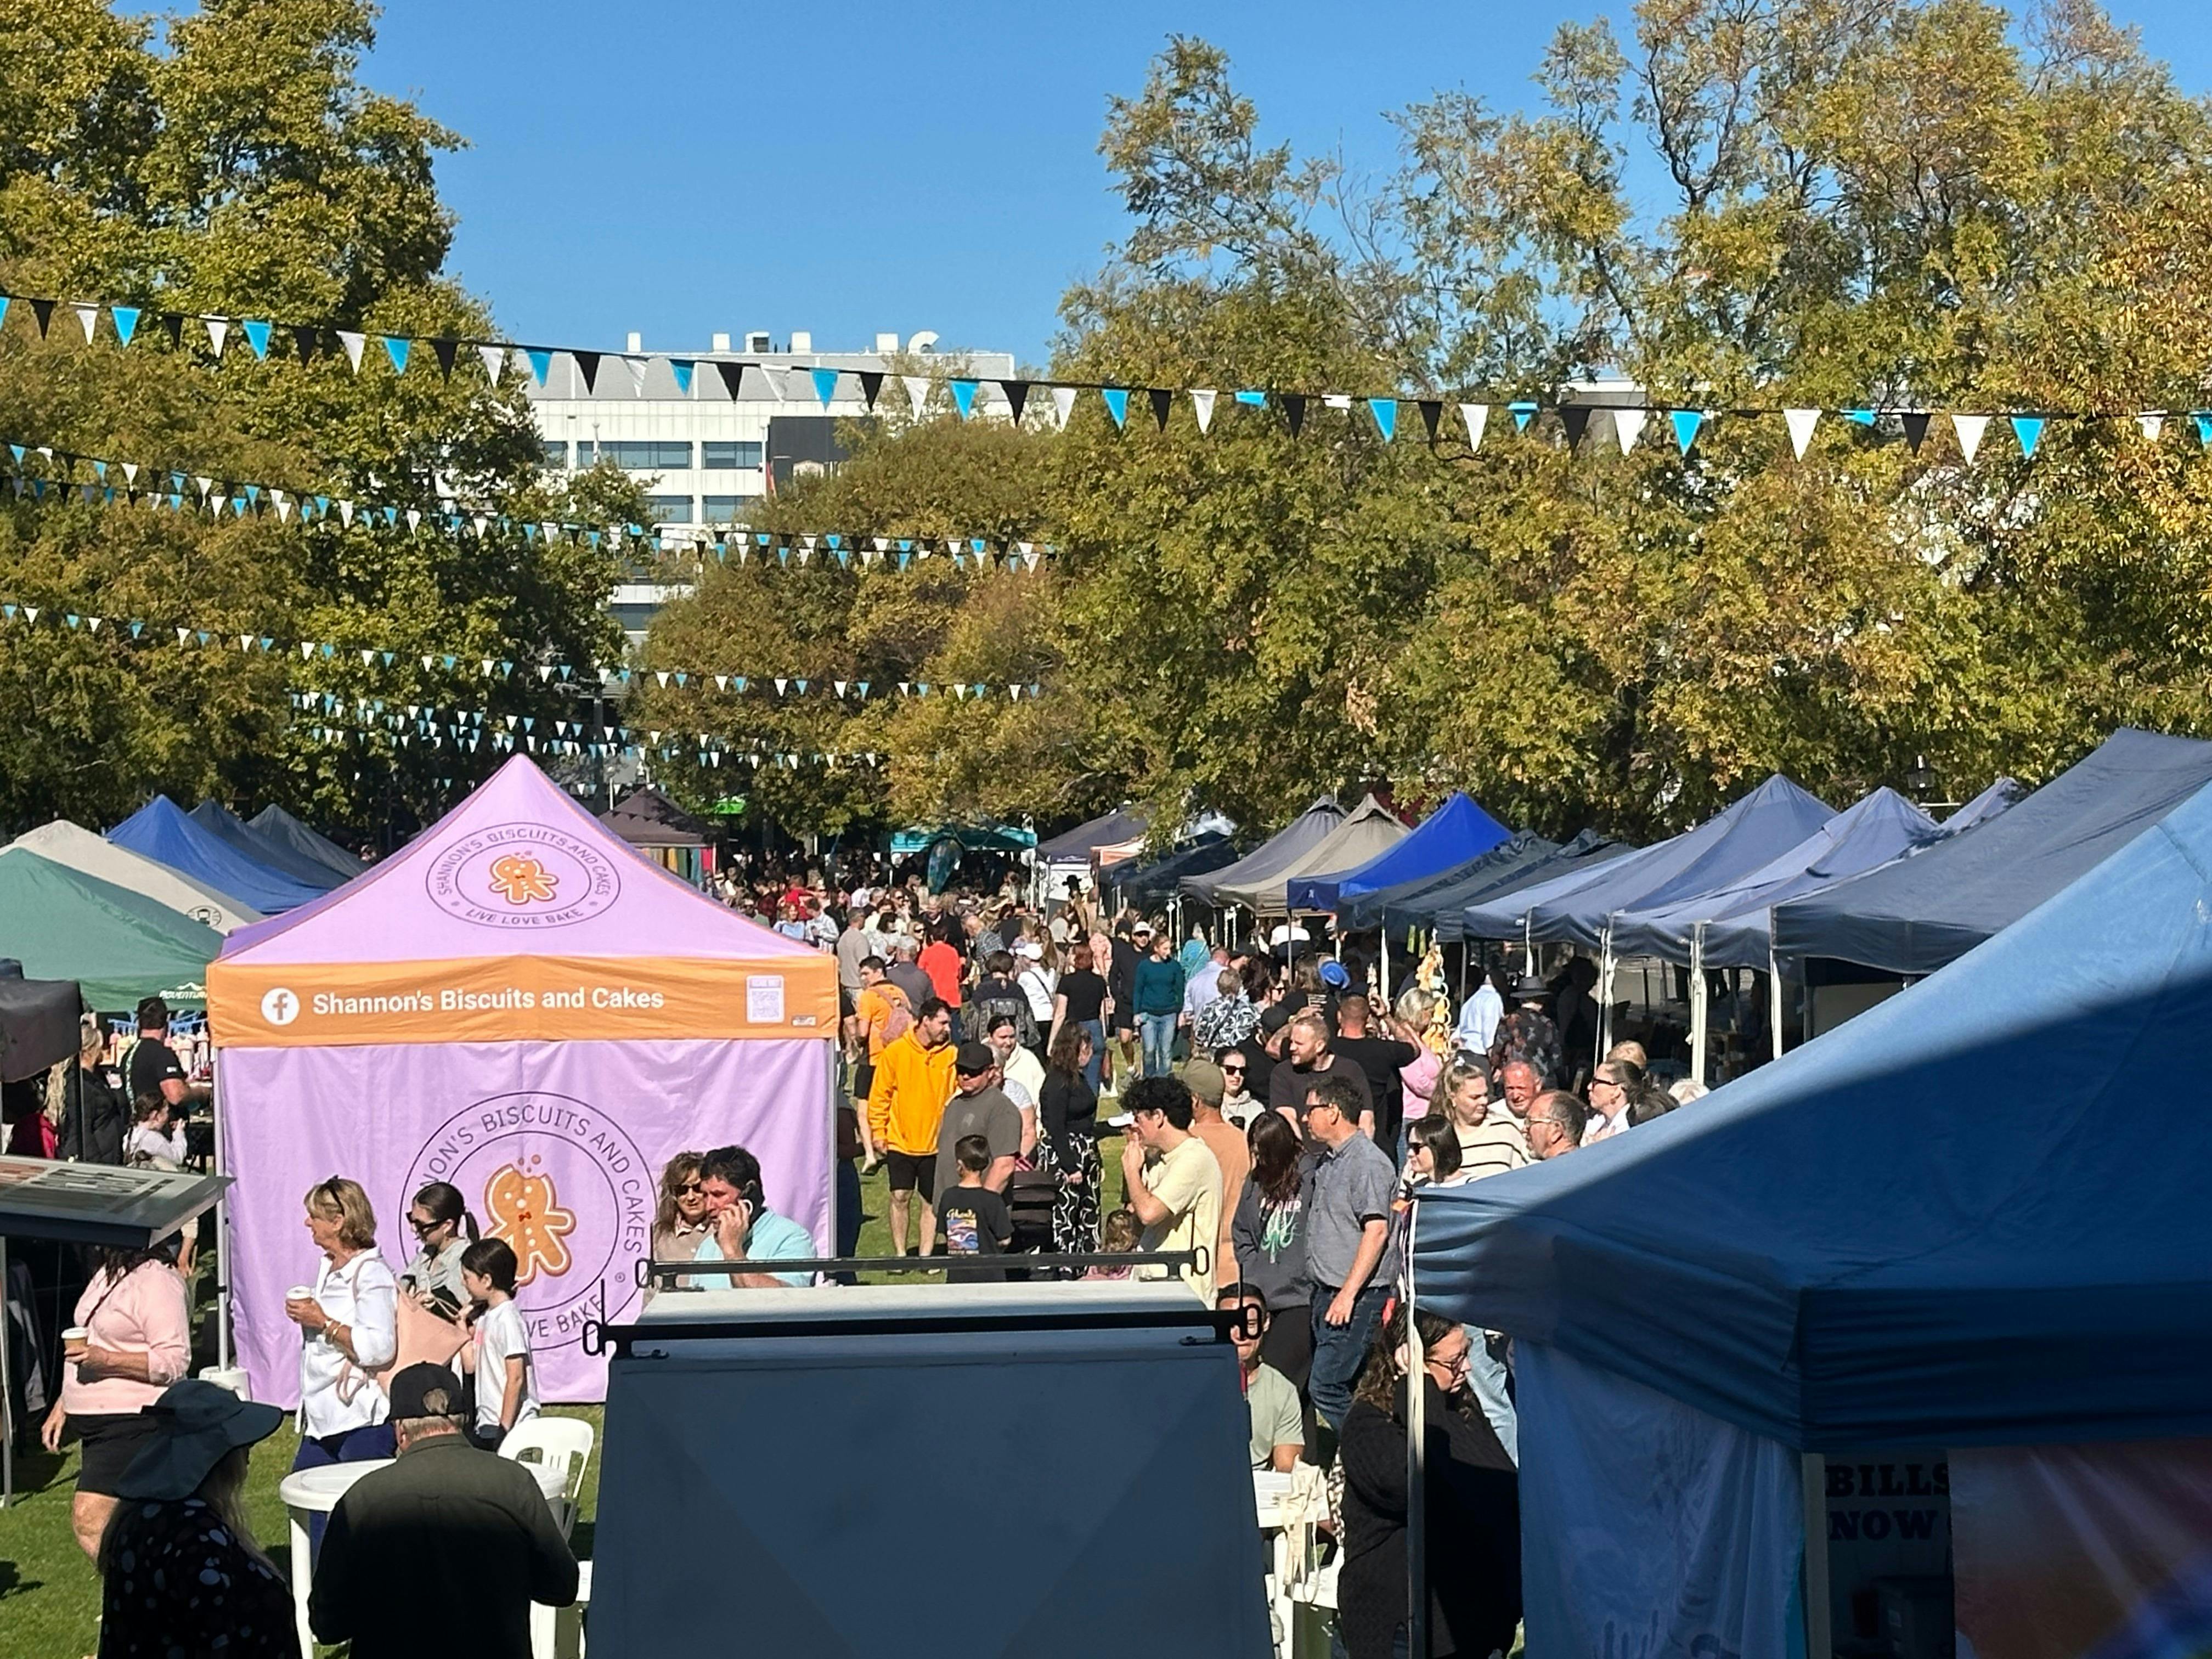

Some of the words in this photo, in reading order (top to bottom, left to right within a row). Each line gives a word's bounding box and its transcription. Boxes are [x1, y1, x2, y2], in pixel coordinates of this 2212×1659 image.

[437, 839, 483, 895] SHANNON'S
[487, 828, 567, 847] BISCUITS
[568, 845, 598, 864] AND
[592, 866, 611, 895] CAKES
[465, 908, 496, 922] LIVE
[501, 916, 540, 925] LOVE
[545, 908, 584, 923] BAKE
[312, 990, 433, 1015] Shannon's
[441, 988, 535, 1011] Biscuits
[541, 987, 584, 1008] and
[592, 987, 664, 1008] Cakes
[481, 1104, 590, 1136] BISCUITS
[589, 1132, 630, 1173] AND
[622, 1179, 645, 1253] CAKES
[556, 1294, 602, 1333] BAKE
[1825, 1462, 1949, 1497] BILLS
[1829, 1510, 1938, 1541] NOW
